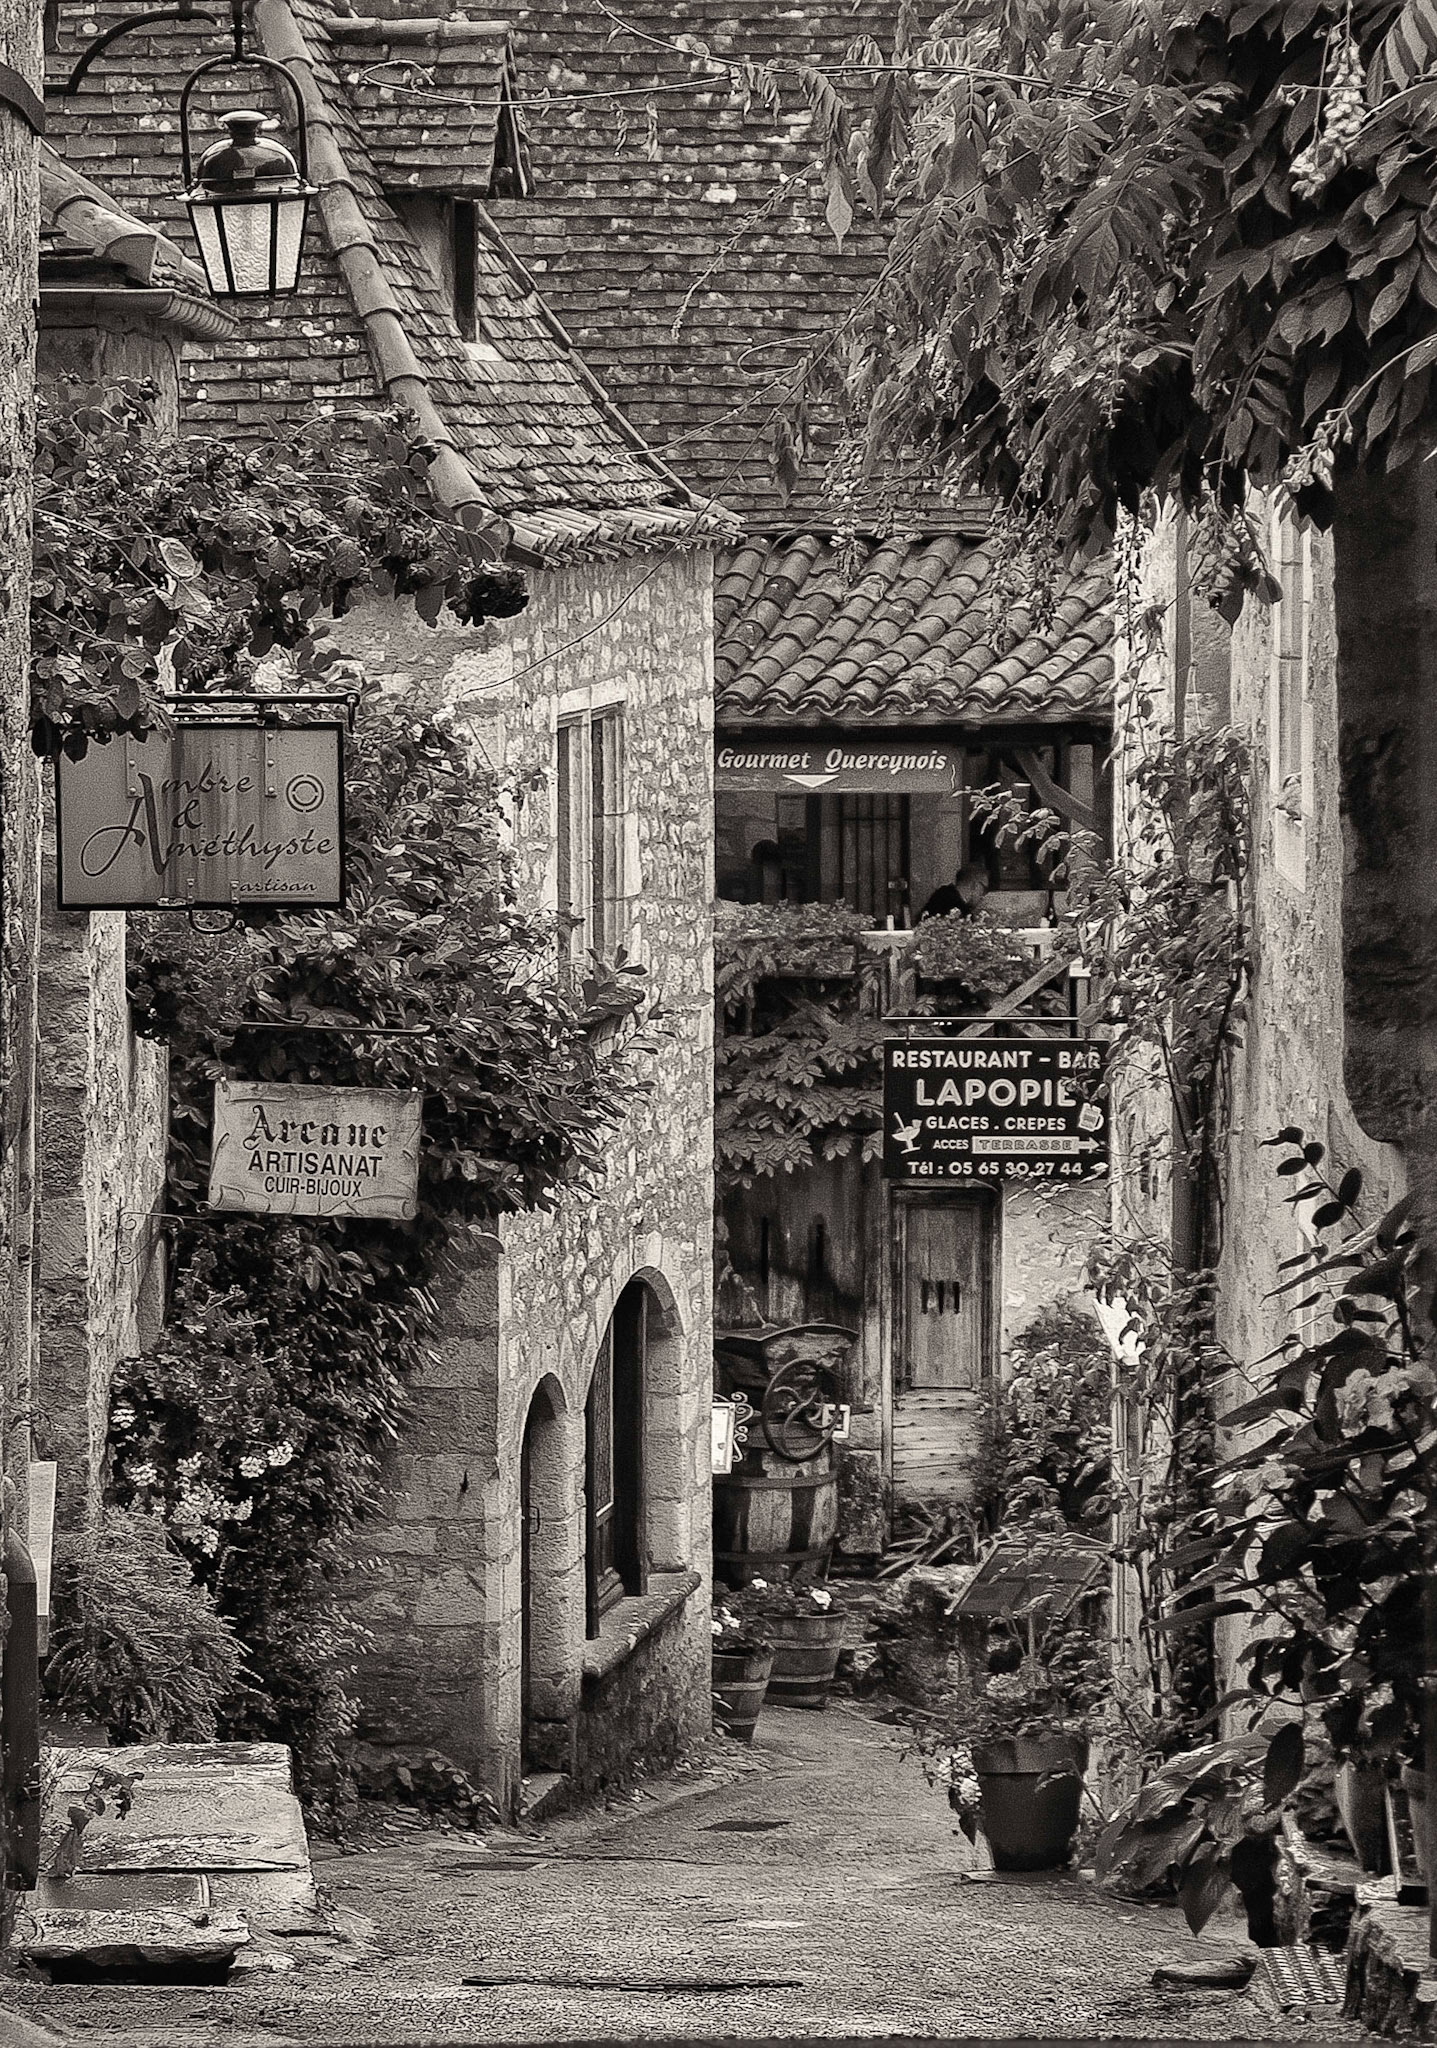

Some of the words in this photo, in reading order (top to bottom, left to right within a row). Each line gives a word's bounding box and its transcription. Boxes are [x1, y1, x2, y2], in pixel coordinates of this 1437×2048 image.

[717, 747, 811, 769] Gourmet
[825, 748, 947, 775] Quercynois
[172, 799, 202, 829] &
[892, 1050, 1032, 1068] RESTAURANT
[1058, 1050, 1101, 1069] BAR
[916, 1078, 1077, 1107] LAPOPIE
[243, 1105, 387, 1150] Arcane
[926, 1116, 989, 1130] GLACES
[1004, 1117, 1066, 1131] CREPES
[933, 1139, 969, 1150] ACCES
[979, 1139, 1072, 1151] TERRASSE
[248, 1150, 382, 1178] ARTISANAT
[948, 1162, 973, 1175] 05
[978, 1162, 999, 1175] 65
[1005, 1162, 1029, 1175] 30
[1034, 1162, 1055, 1175] 27
[1059, 1162, 1083, 1175] 44
[264, 1175, 362, 1198] CUIR-BIJOUX
